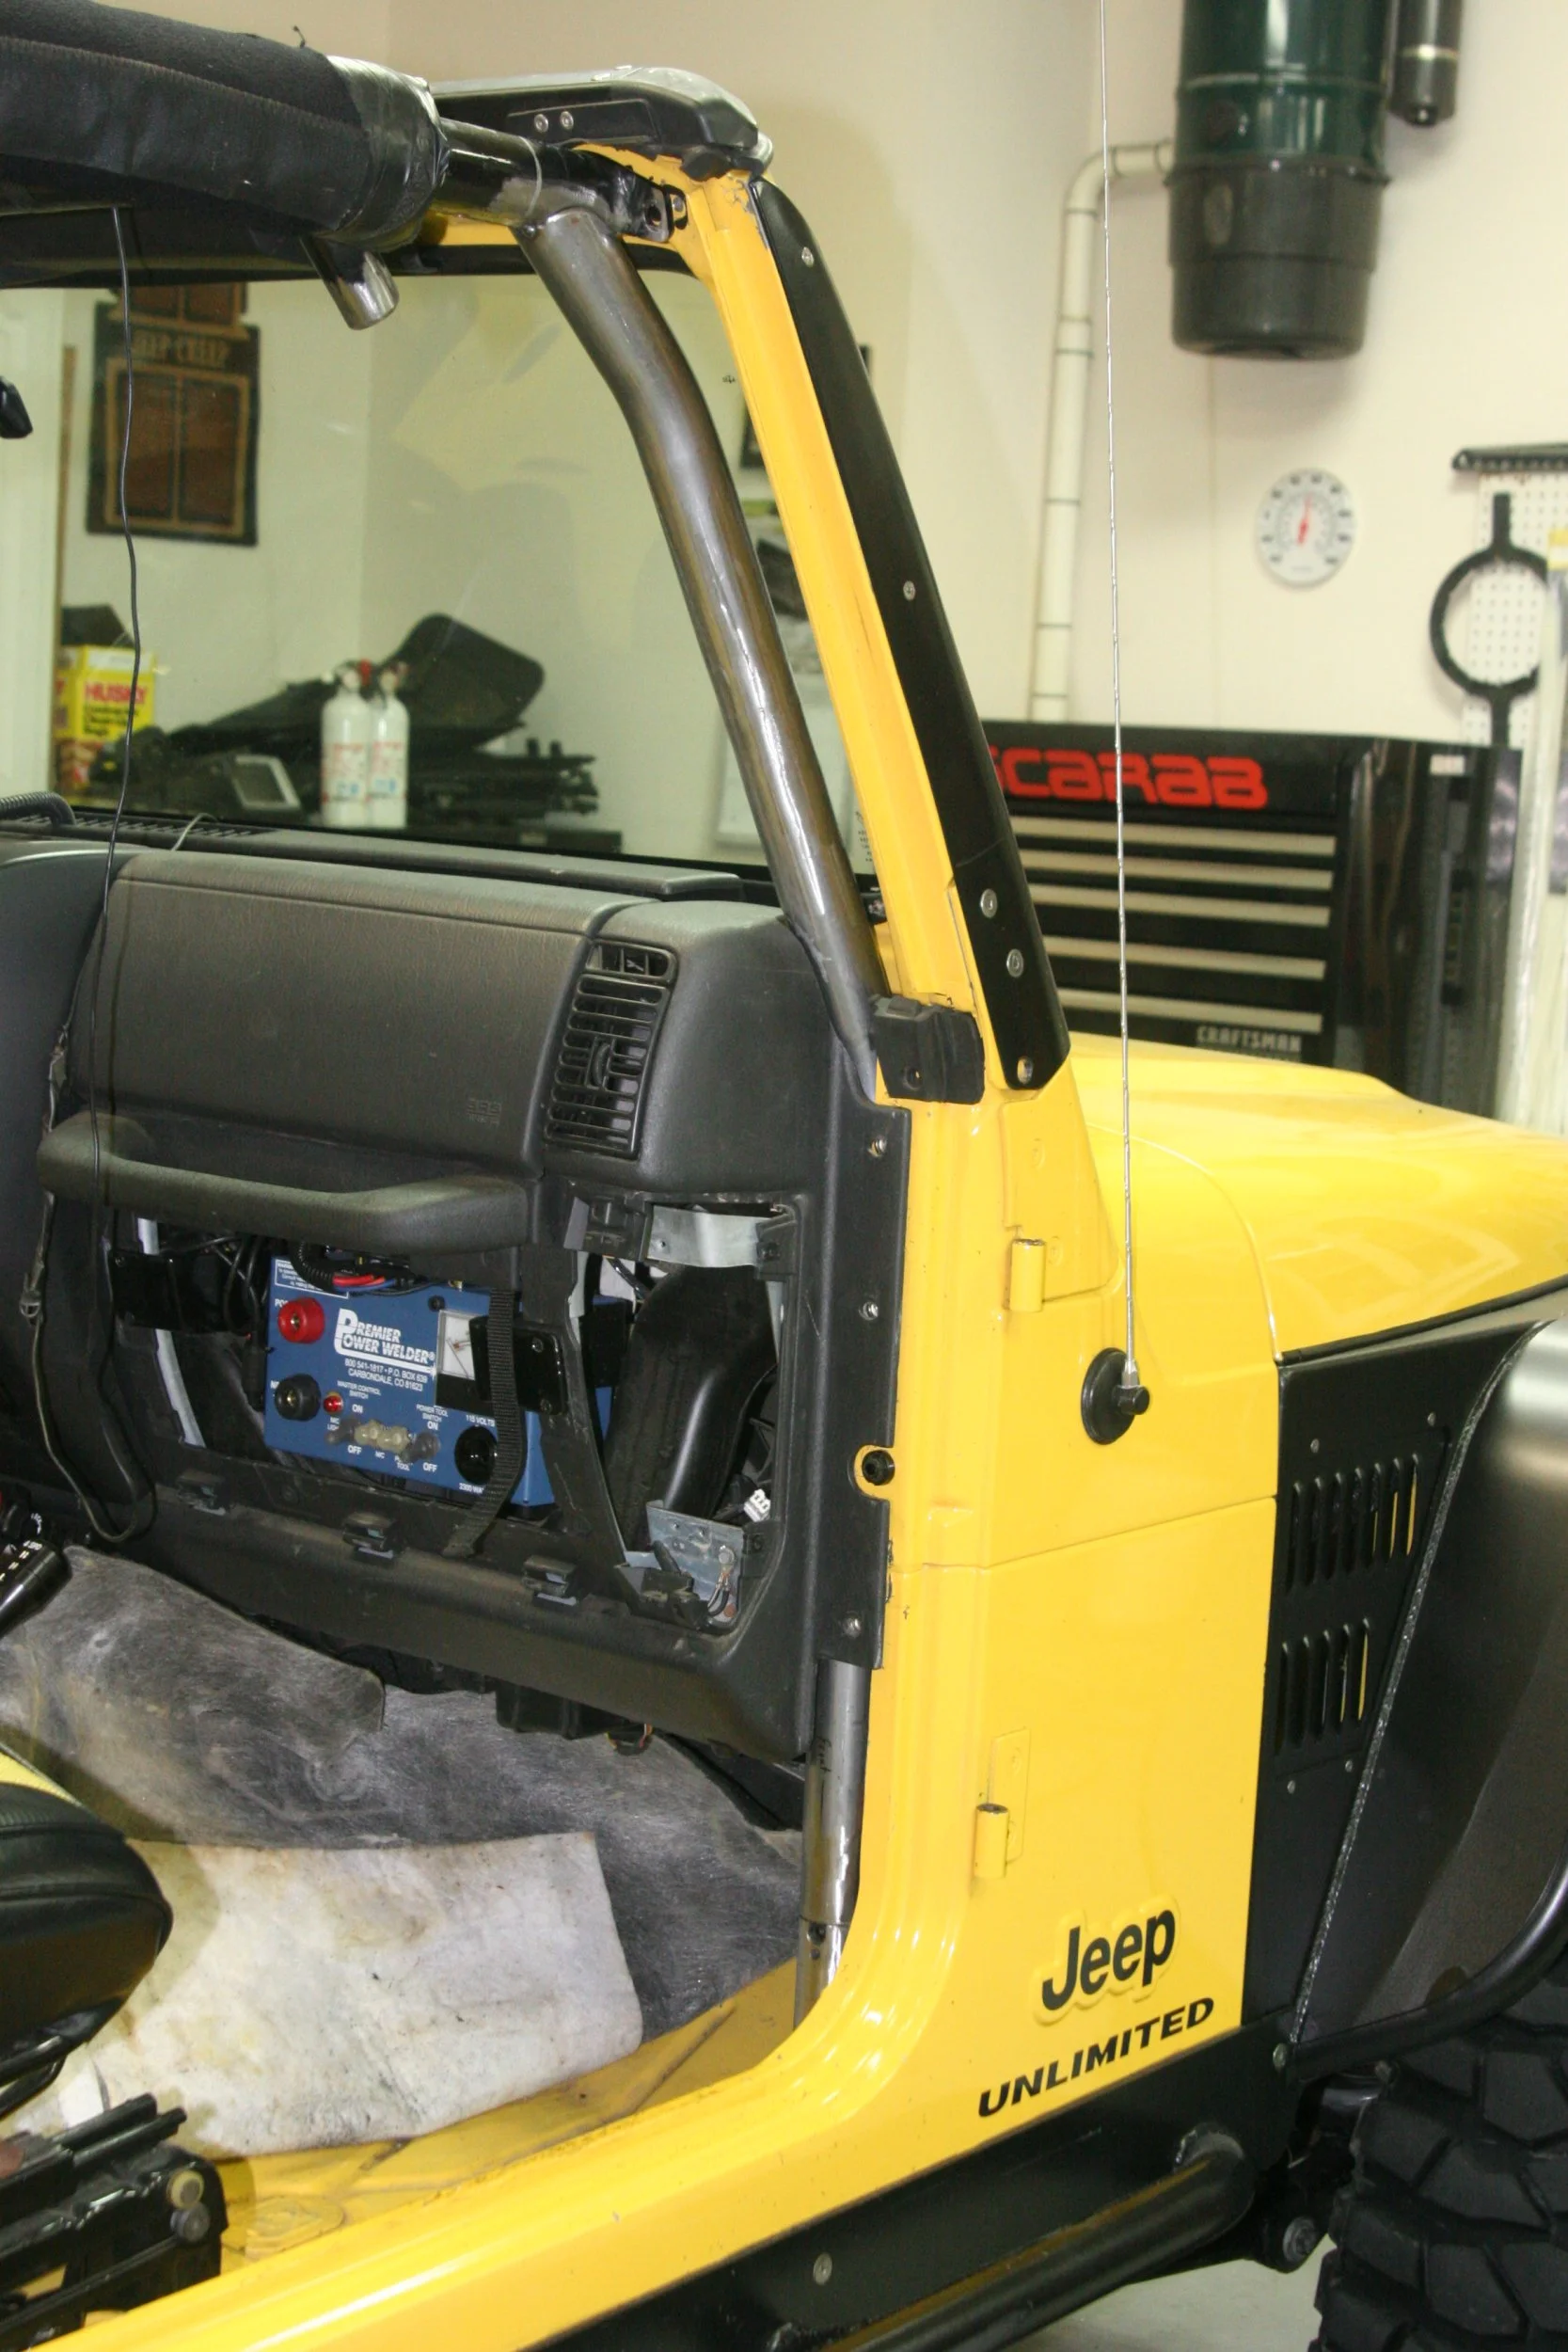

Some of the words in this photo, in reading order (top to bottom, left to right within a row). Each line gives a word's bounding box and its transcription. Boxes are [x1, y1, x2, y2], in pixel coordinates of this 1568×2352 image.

[989, 746, 1268, 810] CARAB
[336, 1308, 401, 1343] PREMIER
[402, 1370, 416, 1381] BOX
[394, 1377, 404, 1388] CO
[357, 1385, 381, 1396] CONTROL
[352, 1404, 363, 1414] ON
[427, 1421, 438, 1430] ON
[347, 1445, 362, 1455] OFF
[422, 1462, 437, 1472] OFF
[1042, 1910, 1176, 2011] Jeep
[978, 1997, 1214, 2118] UNLIMITED
